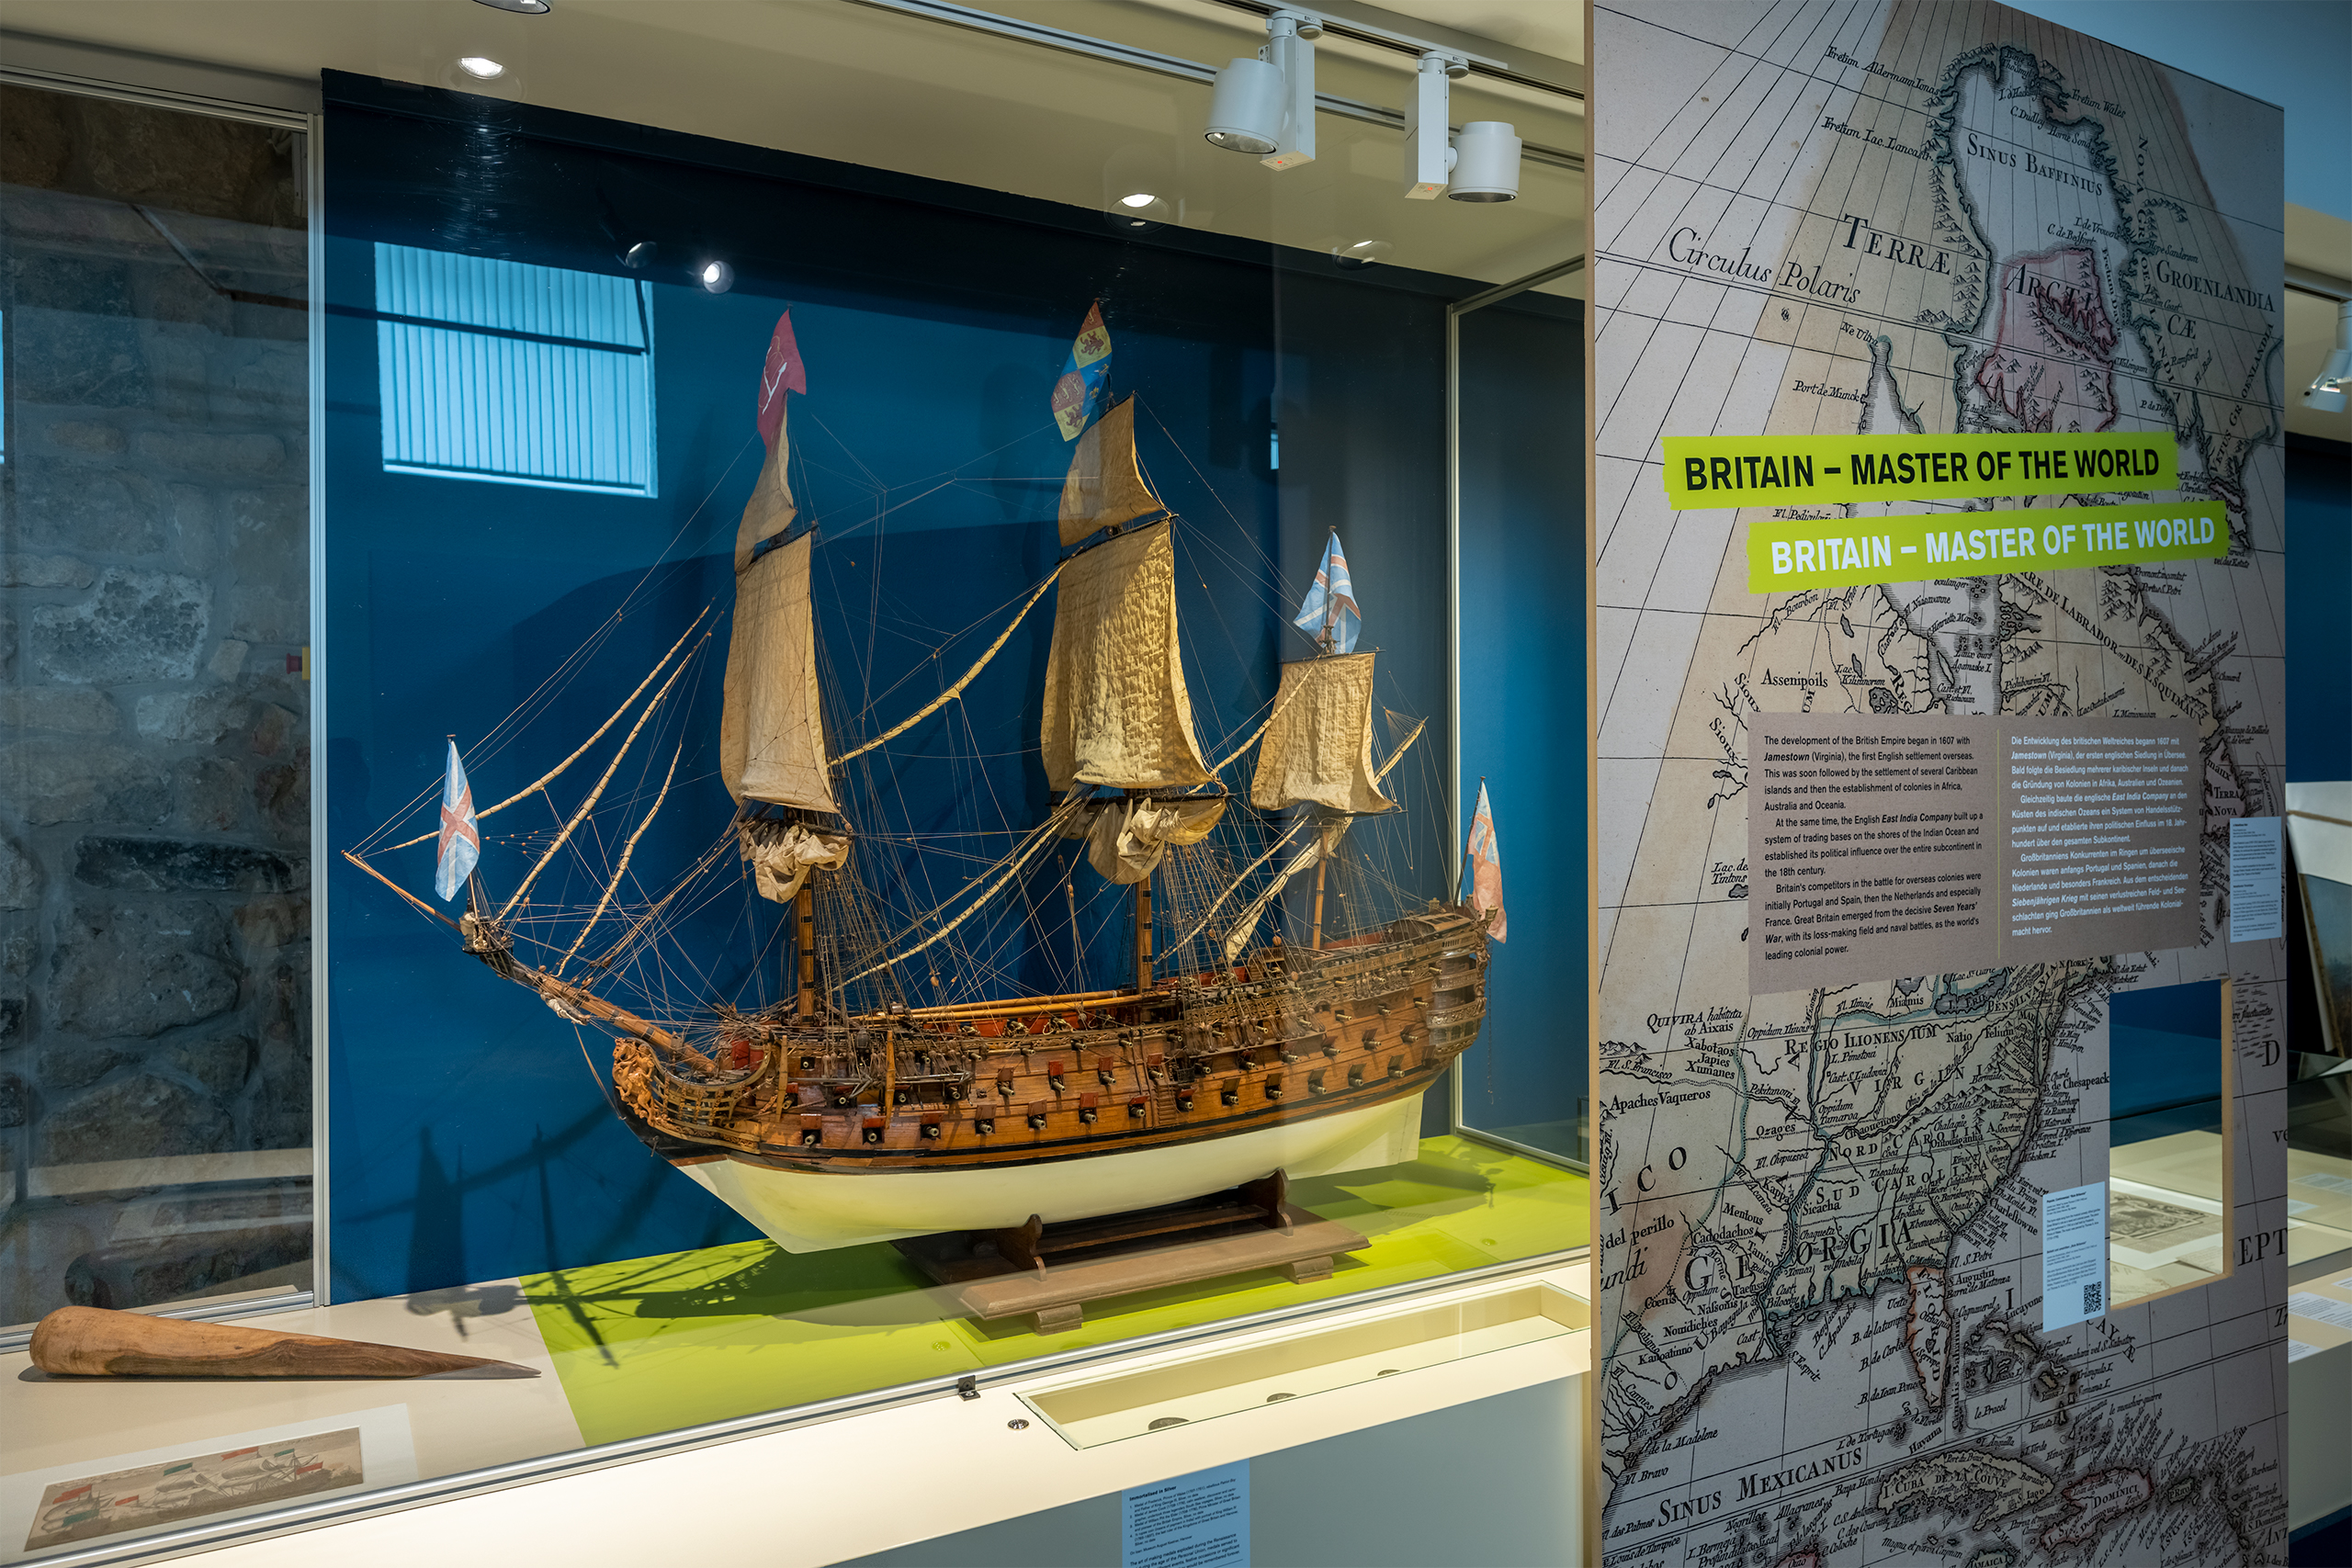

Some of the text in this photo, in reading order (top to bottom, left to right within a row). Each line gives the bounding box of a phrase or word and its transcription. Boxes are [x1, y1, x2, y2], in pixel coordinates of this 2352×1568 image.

[1967, 132, 2103, 197] SINUS BAFFINIUS
[1668, 226, 1861, 305] Circulus Polaris
[2155, 258, 2277, 314] GROENLANDIA
[1684, 455, 1815, 491] BRITAIN
[1850, 452, 1968, 486] MASTER
[1976, 450, 2012, 482] OF
[2019, 450, 2068, 480] THE
[2074, 448, 2160, 479] WORLD
[1770, 535, 1893, 575] BRITAIN
[1926, 526, 2035, 564] MASTER
[2042, 525, 2077, 556] OF
[2082, 521, 2132, 552] THE
[2133, 516, 2215, 549] WORLD
[2060, 595, 2120, 655] LABRADOR
[1764, 736, 1970, 747] The development of the British Empire began in 1607 with
[2012, 737, 2179, 748] Die Entwicklung des britischen Weltreiches begann 1607 mit
[1764, 752, 1810, 761] Jamestown
[1811, 752, 1847, 763] (Virginia),
[1848, 752, 1860, 761] the
[1861, 752, 1876, 761] first
[1877, 752, 1904, 762] English
[1905, 751, 1941, 761] settlement
[2011, 750, 2047, 760] Jamestown
[2075, 750, 2086, 760] der
[2086, 750, 2103, 760] ersten
[2104, 750, 2133, 761] englischen
[2133, 750, 2157, 761] Siedlung
[2157, 750, 2163, 760] in
[2163, 749, 2187, 760] Übersee.
[1764, 769, 1781, 778] This
[1818, 768, 1849, 777] followed
[1850, 768, 1860, 779] by
[1860, 768, 1872, 777] the
[1874, 767, 1911, 776] settlement
[1911, 767, 1919, 776] of
[1920, 767, 1944, 776] several
[1945, 767, 1978, 776] Caribbean
[1765, 783, 1962, 795] islands and then the establishment of colonies in Africa,
[1764, 801, 1846, 811] Australia and Oceania.
[2214, 806, 2238, 817] NOVA
[1776, 812, 1984, 827] At the same time, the English East India Company built up a
[1765, 827, 1979, 846] system of trading bases on the shores of the Indian Ocean and
[1610, 1090, 1712, 1115] Apaches Vaqueros
[1605, 1214, 1675, 1250] del perillo
[1908, 1427, 1943, 1453] Havana
[1657, 1447, 1862, 1528] SINUS MEXICANUS
